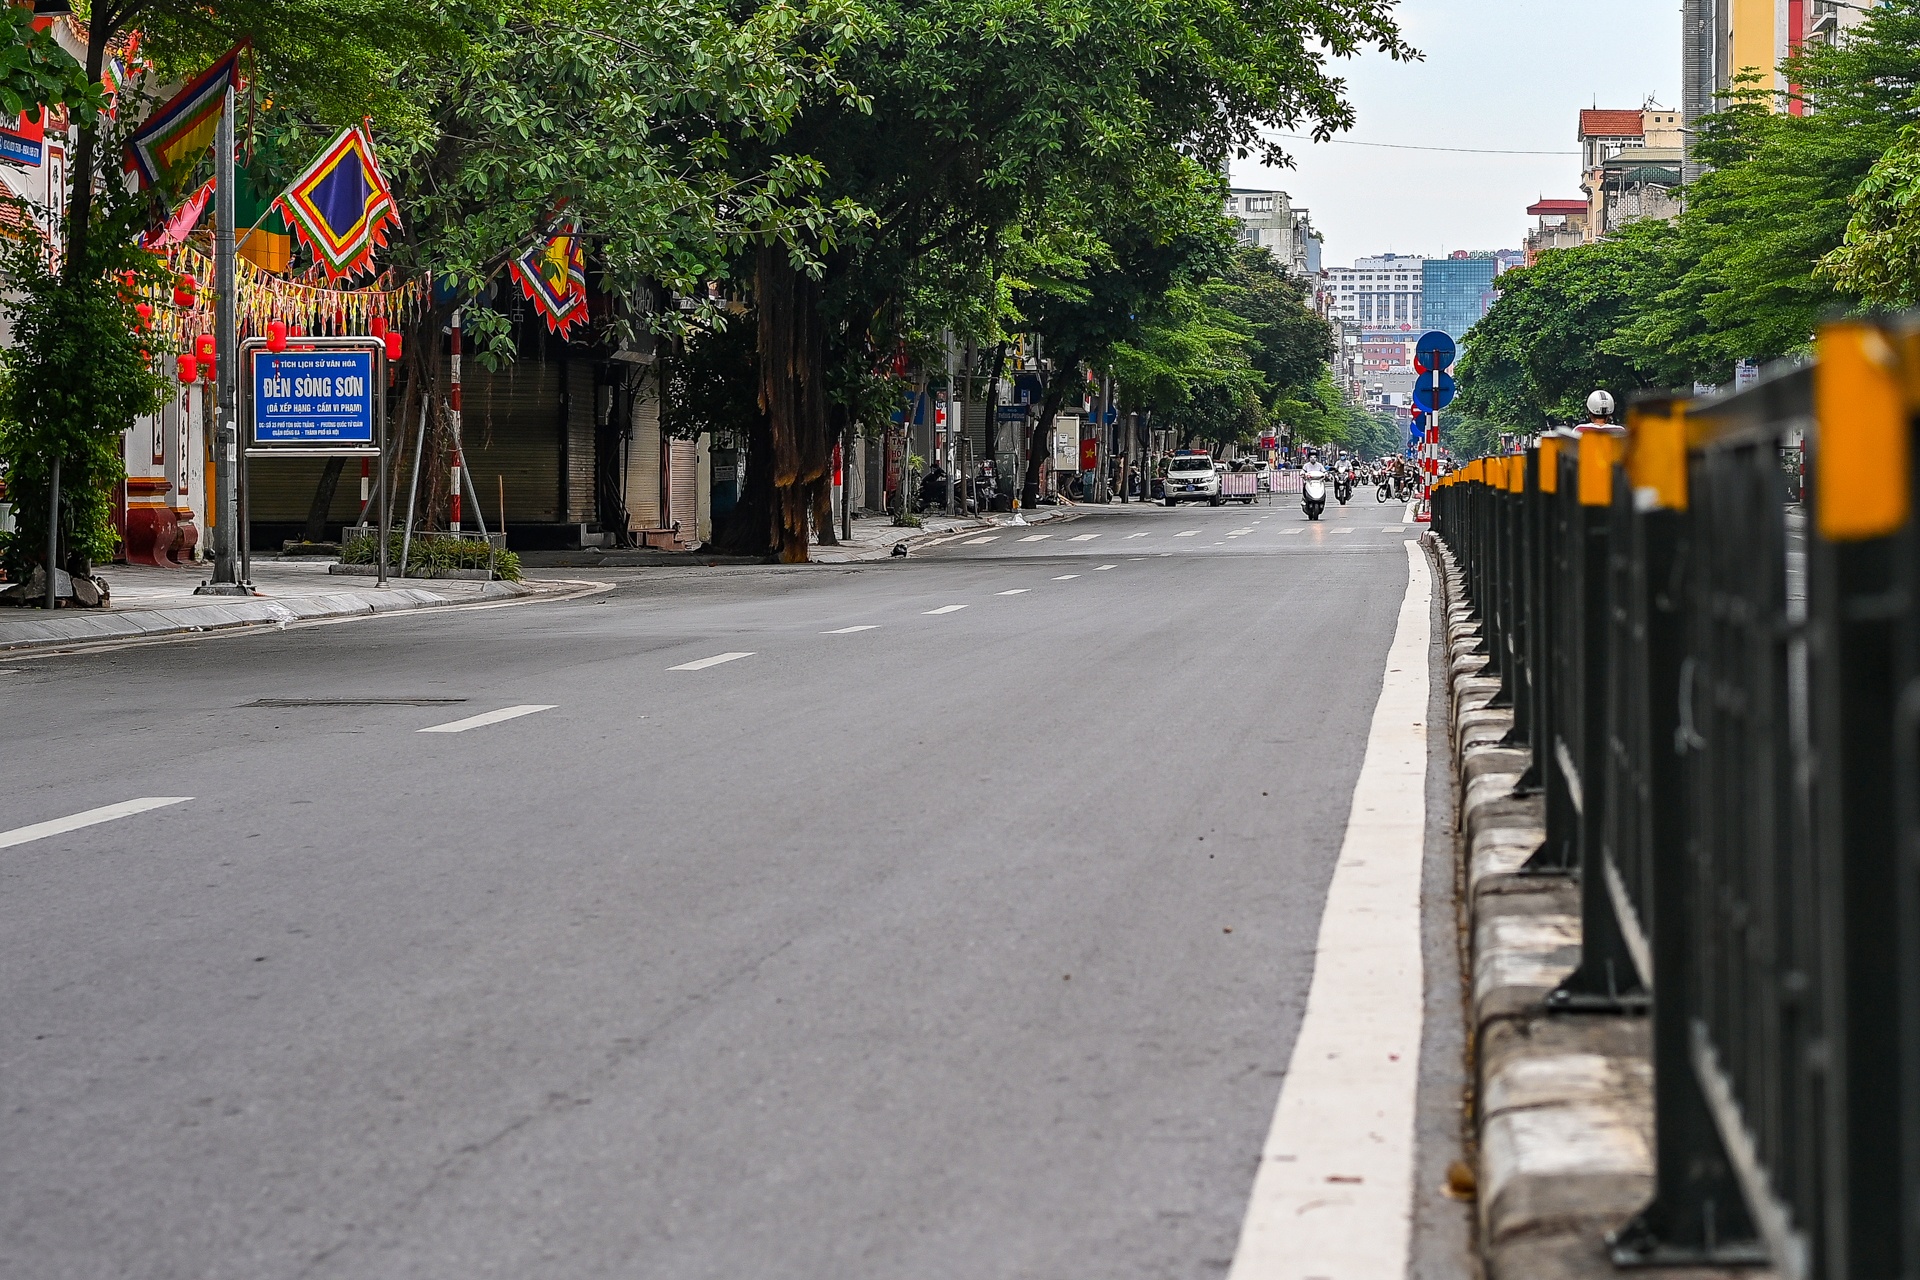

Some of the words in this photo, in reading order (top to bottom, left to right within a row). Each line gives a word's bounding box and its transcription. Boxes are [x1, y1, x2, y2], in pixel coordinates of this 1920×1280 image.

[281, 359, 297, 368] TÍCH
[297, 360, 313, 369] LỊCH
[315, 358, 325, 368] SỬ
[342, 359, 356, 368] HÓA
[263, 372, 291, 398] ĐỀN
[295, 373, 331, 398] SÒNG
[335, 375, 363, 397] SƠN
[279, 402, 292, 412] XẾP
[293, 403, 311, 414] HẠNG
[317, 402, 332, 413] CẤM
[332, 403, 340, 412] VI
[340, 403, 362, 414] PHẠM)
